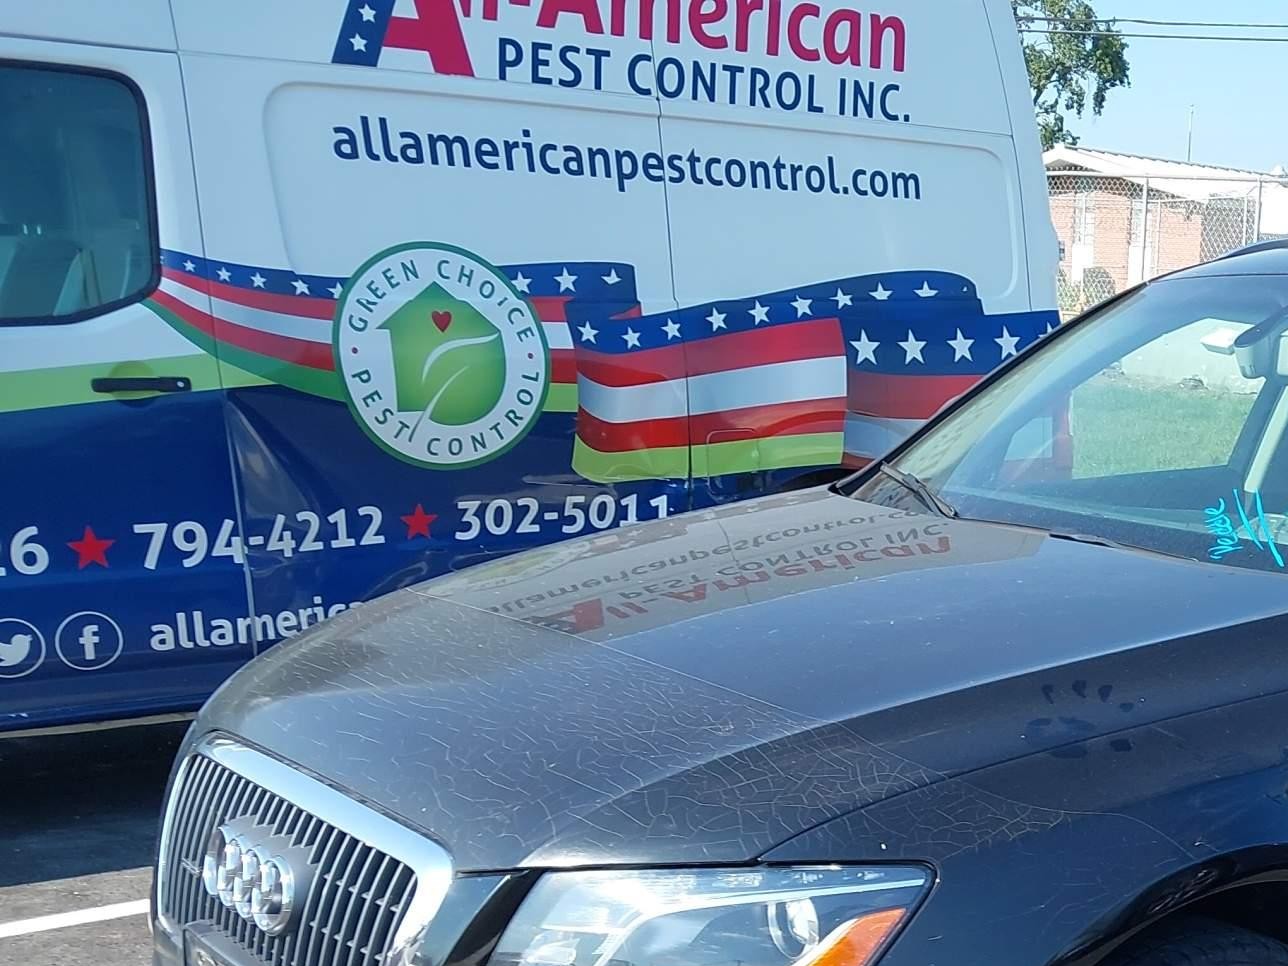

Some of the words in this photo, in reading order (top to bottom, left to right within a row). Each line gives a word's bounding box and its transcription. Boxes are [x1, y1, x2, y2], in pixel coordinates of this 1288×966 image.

[331, 0, 907, 78] A-merican
[499, 38, 611, 90] PEST
[627, 54, 824, 114] CONTROL
[838, 78, 911, 122] INC.
[333, 115, 921, 199] allamericanpestcontrol.com
[349, 259, 420, 333] GREEN
[437, 259, 535, 343] CHOICE
[351, 368, 410, 440] PEST
[427, 371, 540, 456] CONTROL
[133, 506, 385, 570] 794-4212
[454, 494, 669, 541] 302-5011
